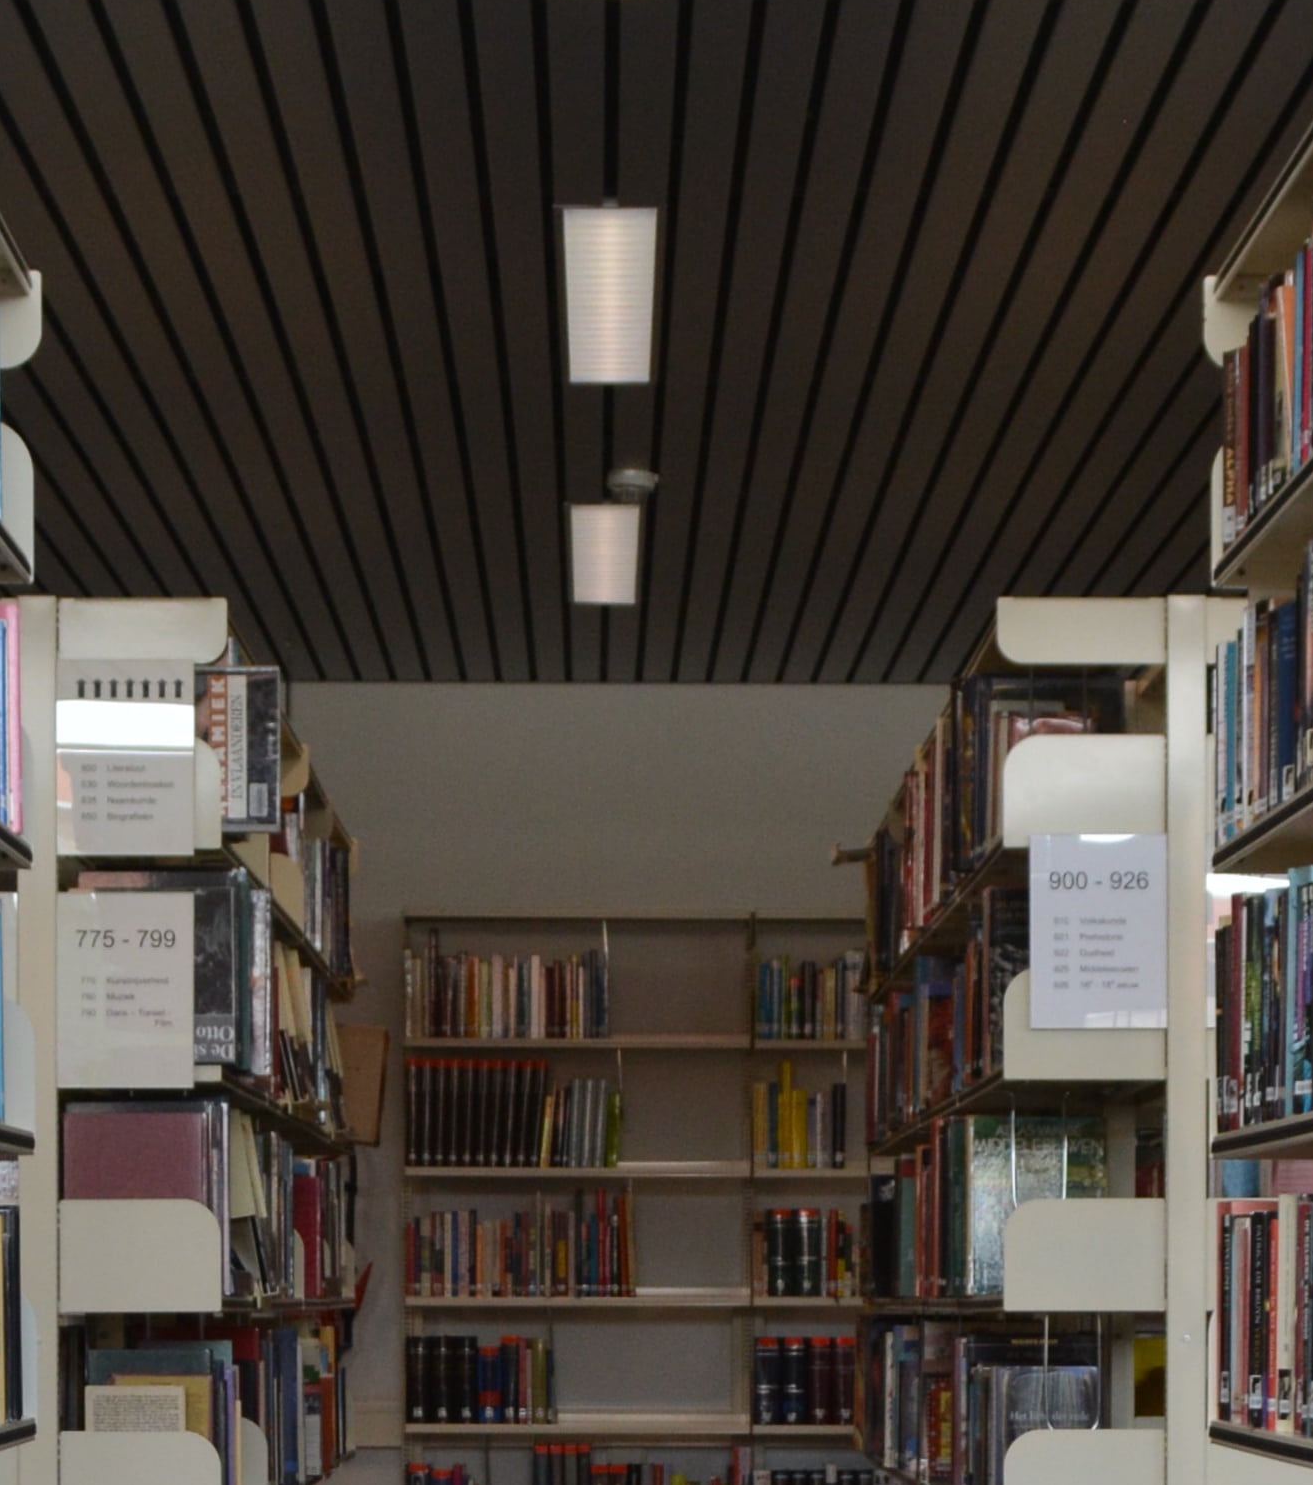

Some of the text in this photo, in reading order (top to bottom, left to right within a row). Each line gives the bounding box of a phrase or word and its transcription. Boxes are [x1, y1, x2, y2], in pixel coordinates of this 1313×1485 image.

[1048, 870, 1151, 891] 900 926
[75, 929, 177, 949] 775 799
